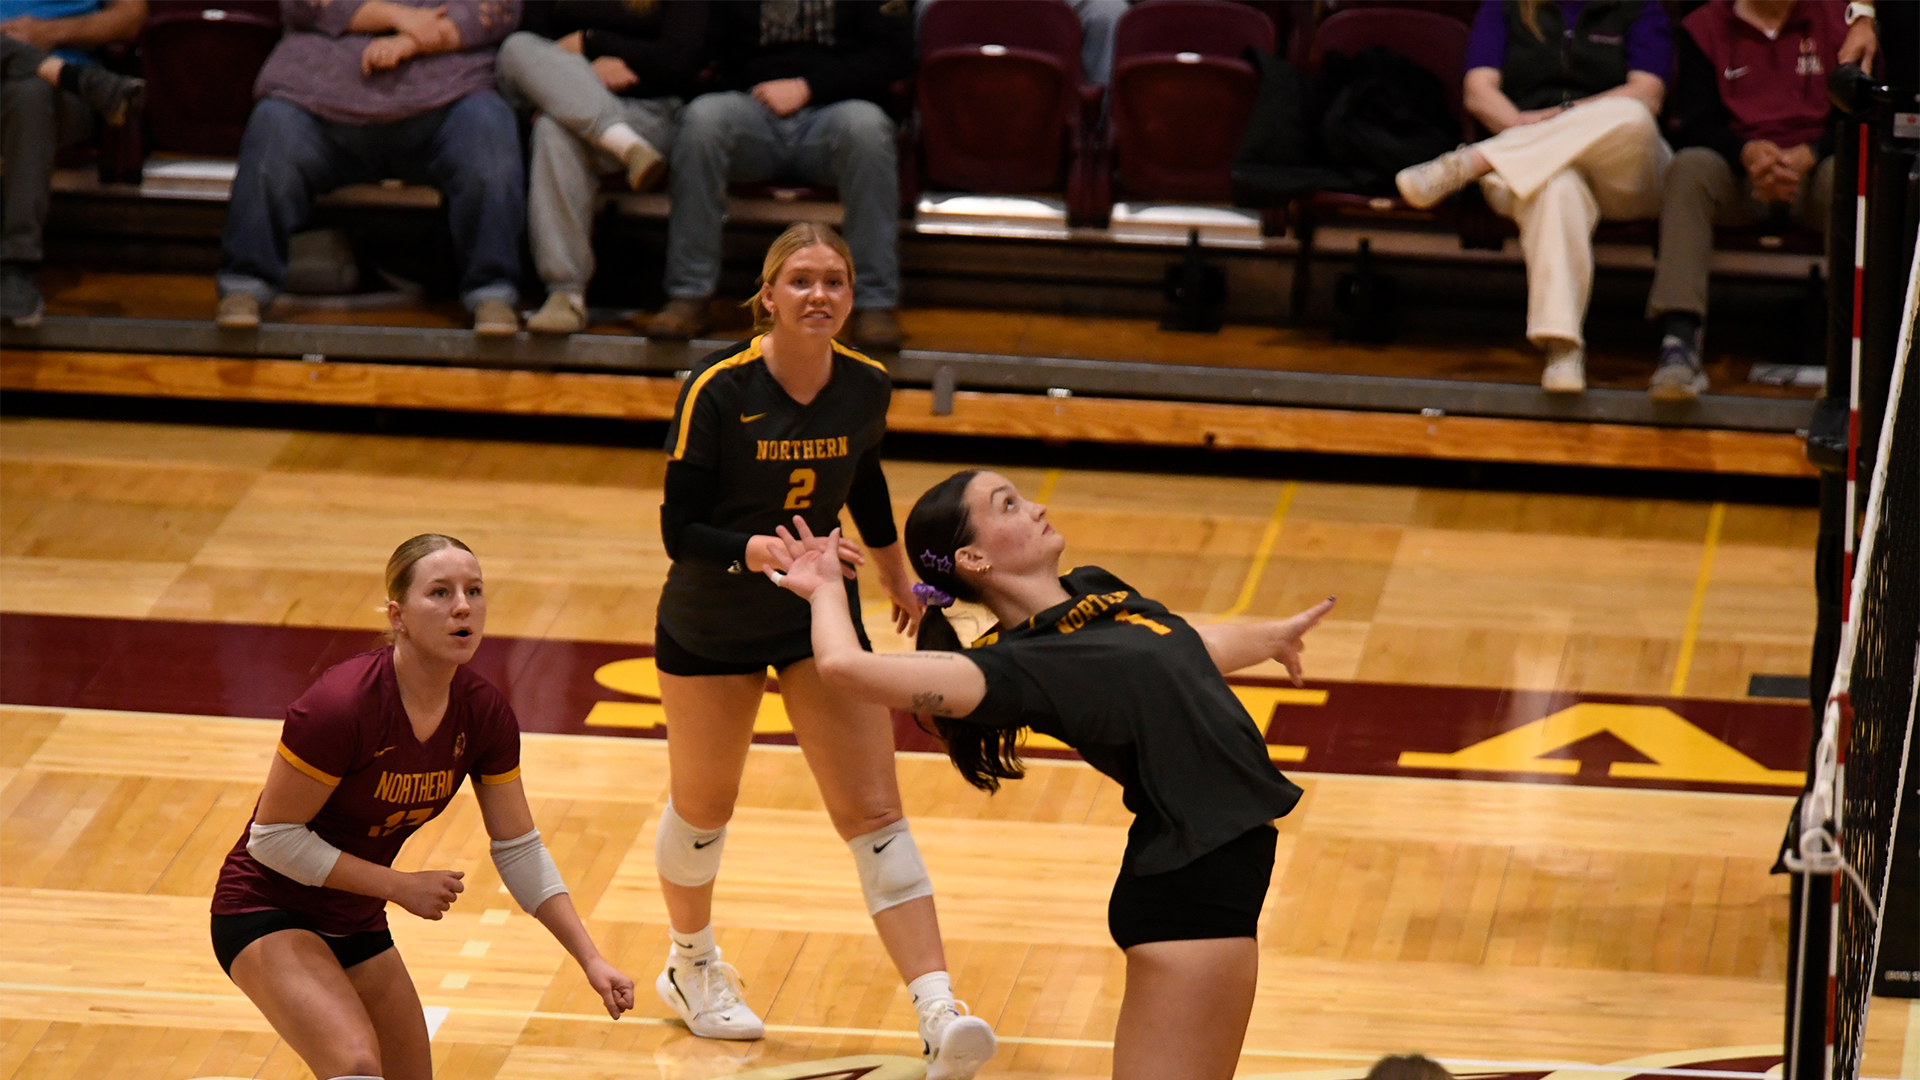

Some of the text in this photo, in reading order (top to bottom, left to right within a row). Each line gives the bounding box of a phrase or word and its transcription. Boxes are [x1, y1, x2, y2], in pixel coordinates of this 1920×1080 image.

[755, 436, 849, 461] NORTHERN
[783, 467, 817, 510] 2
[373, 768, 455, 804] NORTHERN
